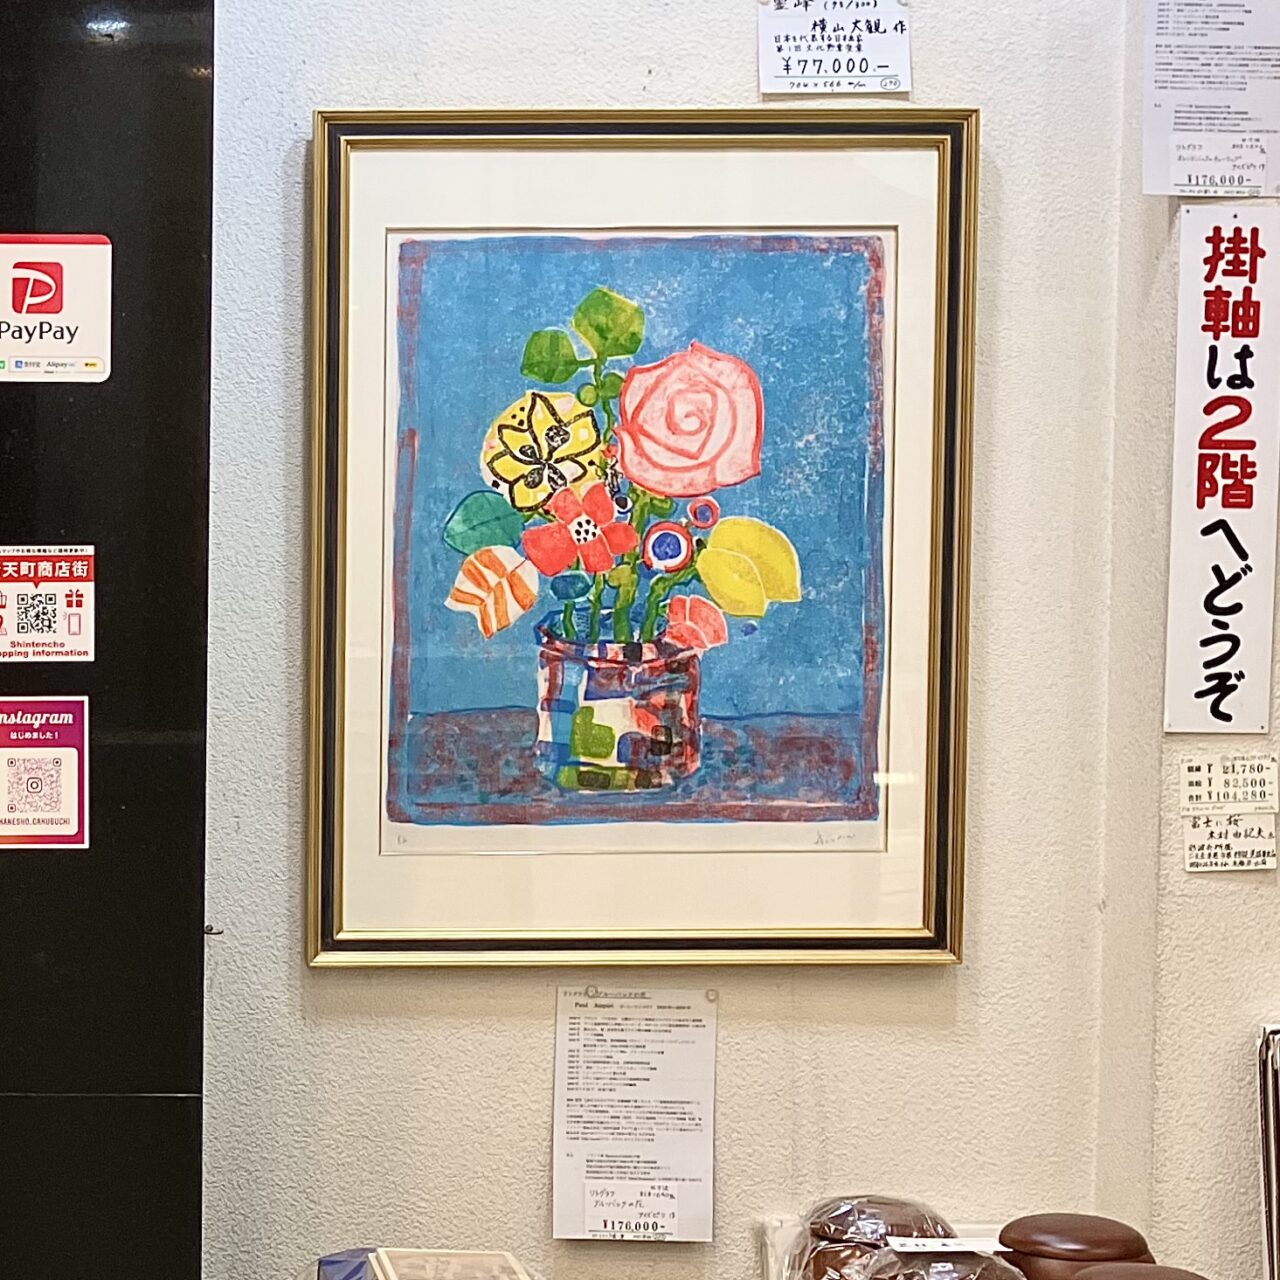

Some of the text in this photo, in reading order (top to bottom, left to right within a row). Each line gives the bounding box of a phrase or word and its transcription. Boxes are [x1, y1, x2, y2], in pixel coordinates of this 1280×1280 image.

[1194, 225, 1267, 723] 掛軸は2階へどうぞ
